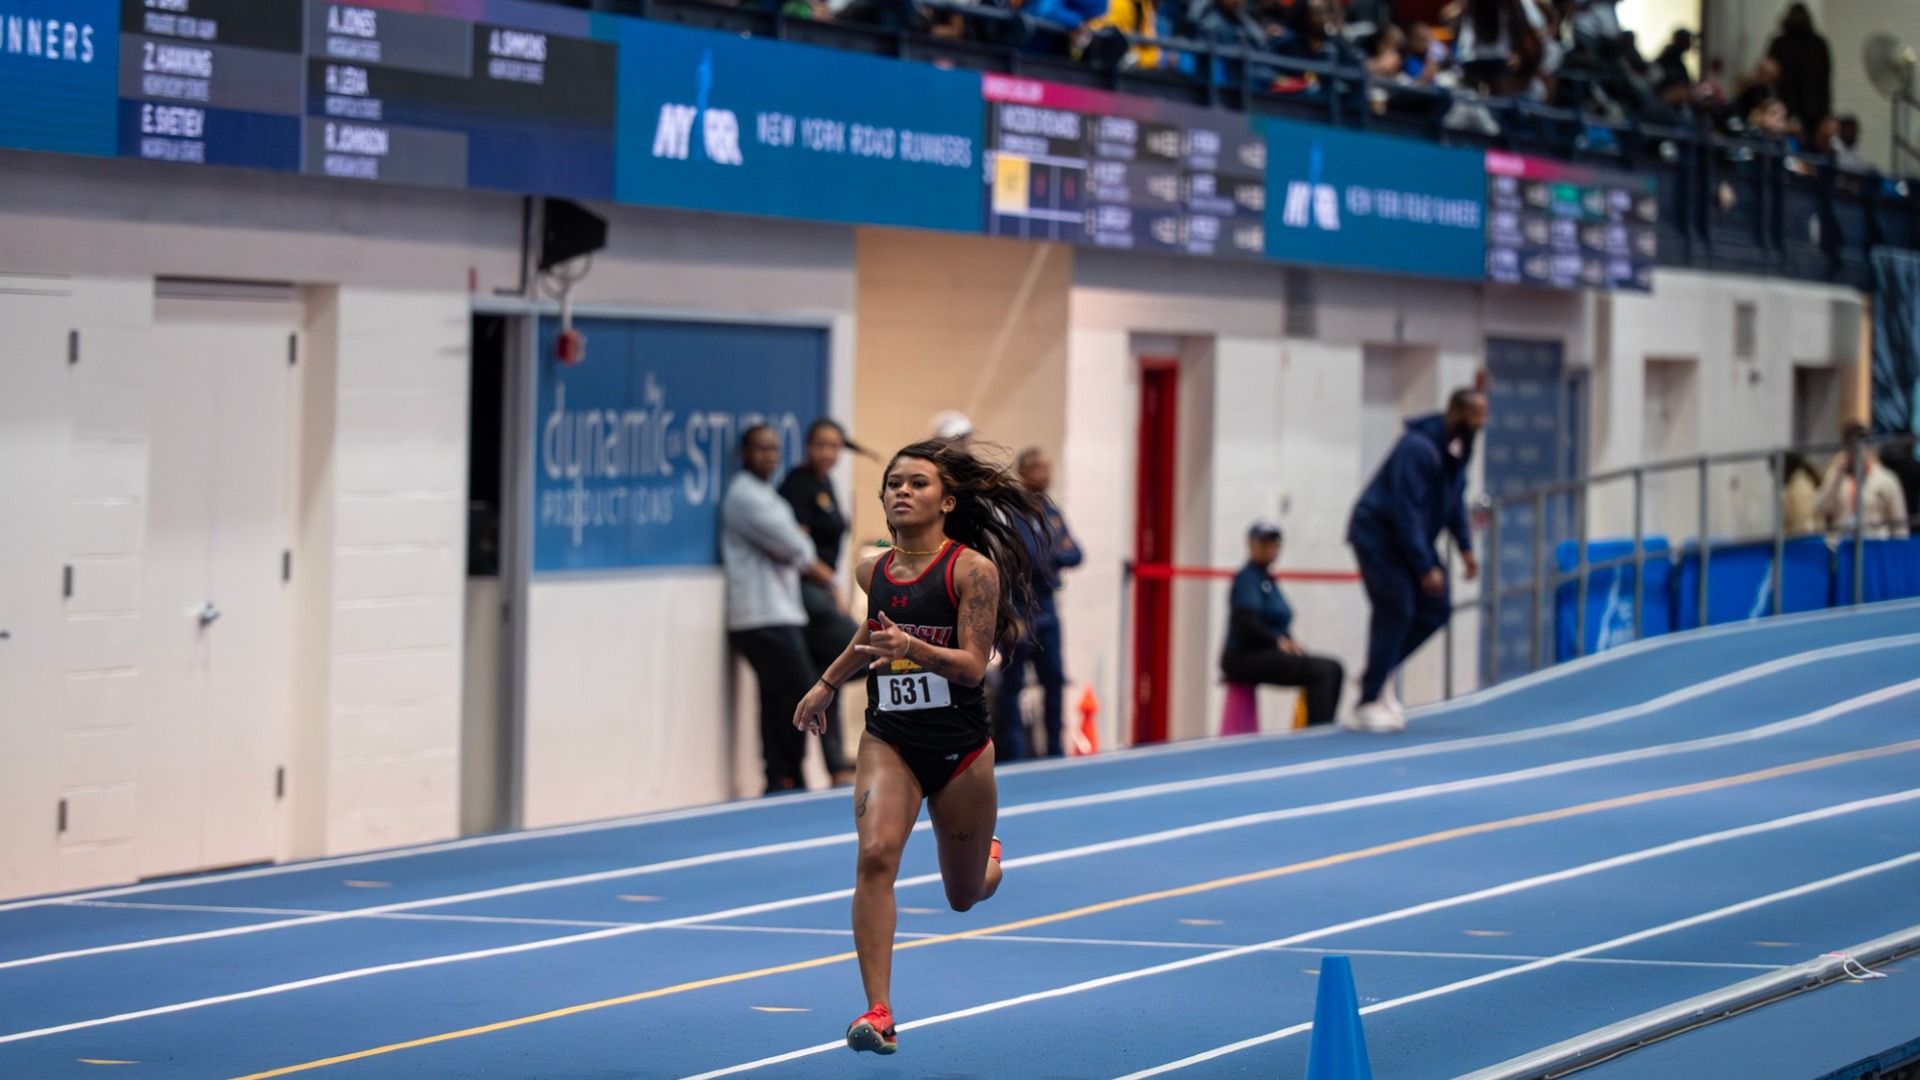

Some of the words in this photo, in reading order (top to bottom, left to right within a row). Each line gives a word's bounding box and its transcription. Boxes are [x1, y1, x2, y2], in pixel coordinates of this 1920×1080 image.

[0, 15, 94, 63] NNERS
[756, 111, 796, 148] NEW
[801, 116, 846, 153] YORK
[850, 122, 896, 160] ROAD
[899, 129, 972, 169] RUNNERS
[889, 676, 931, 705] 631
